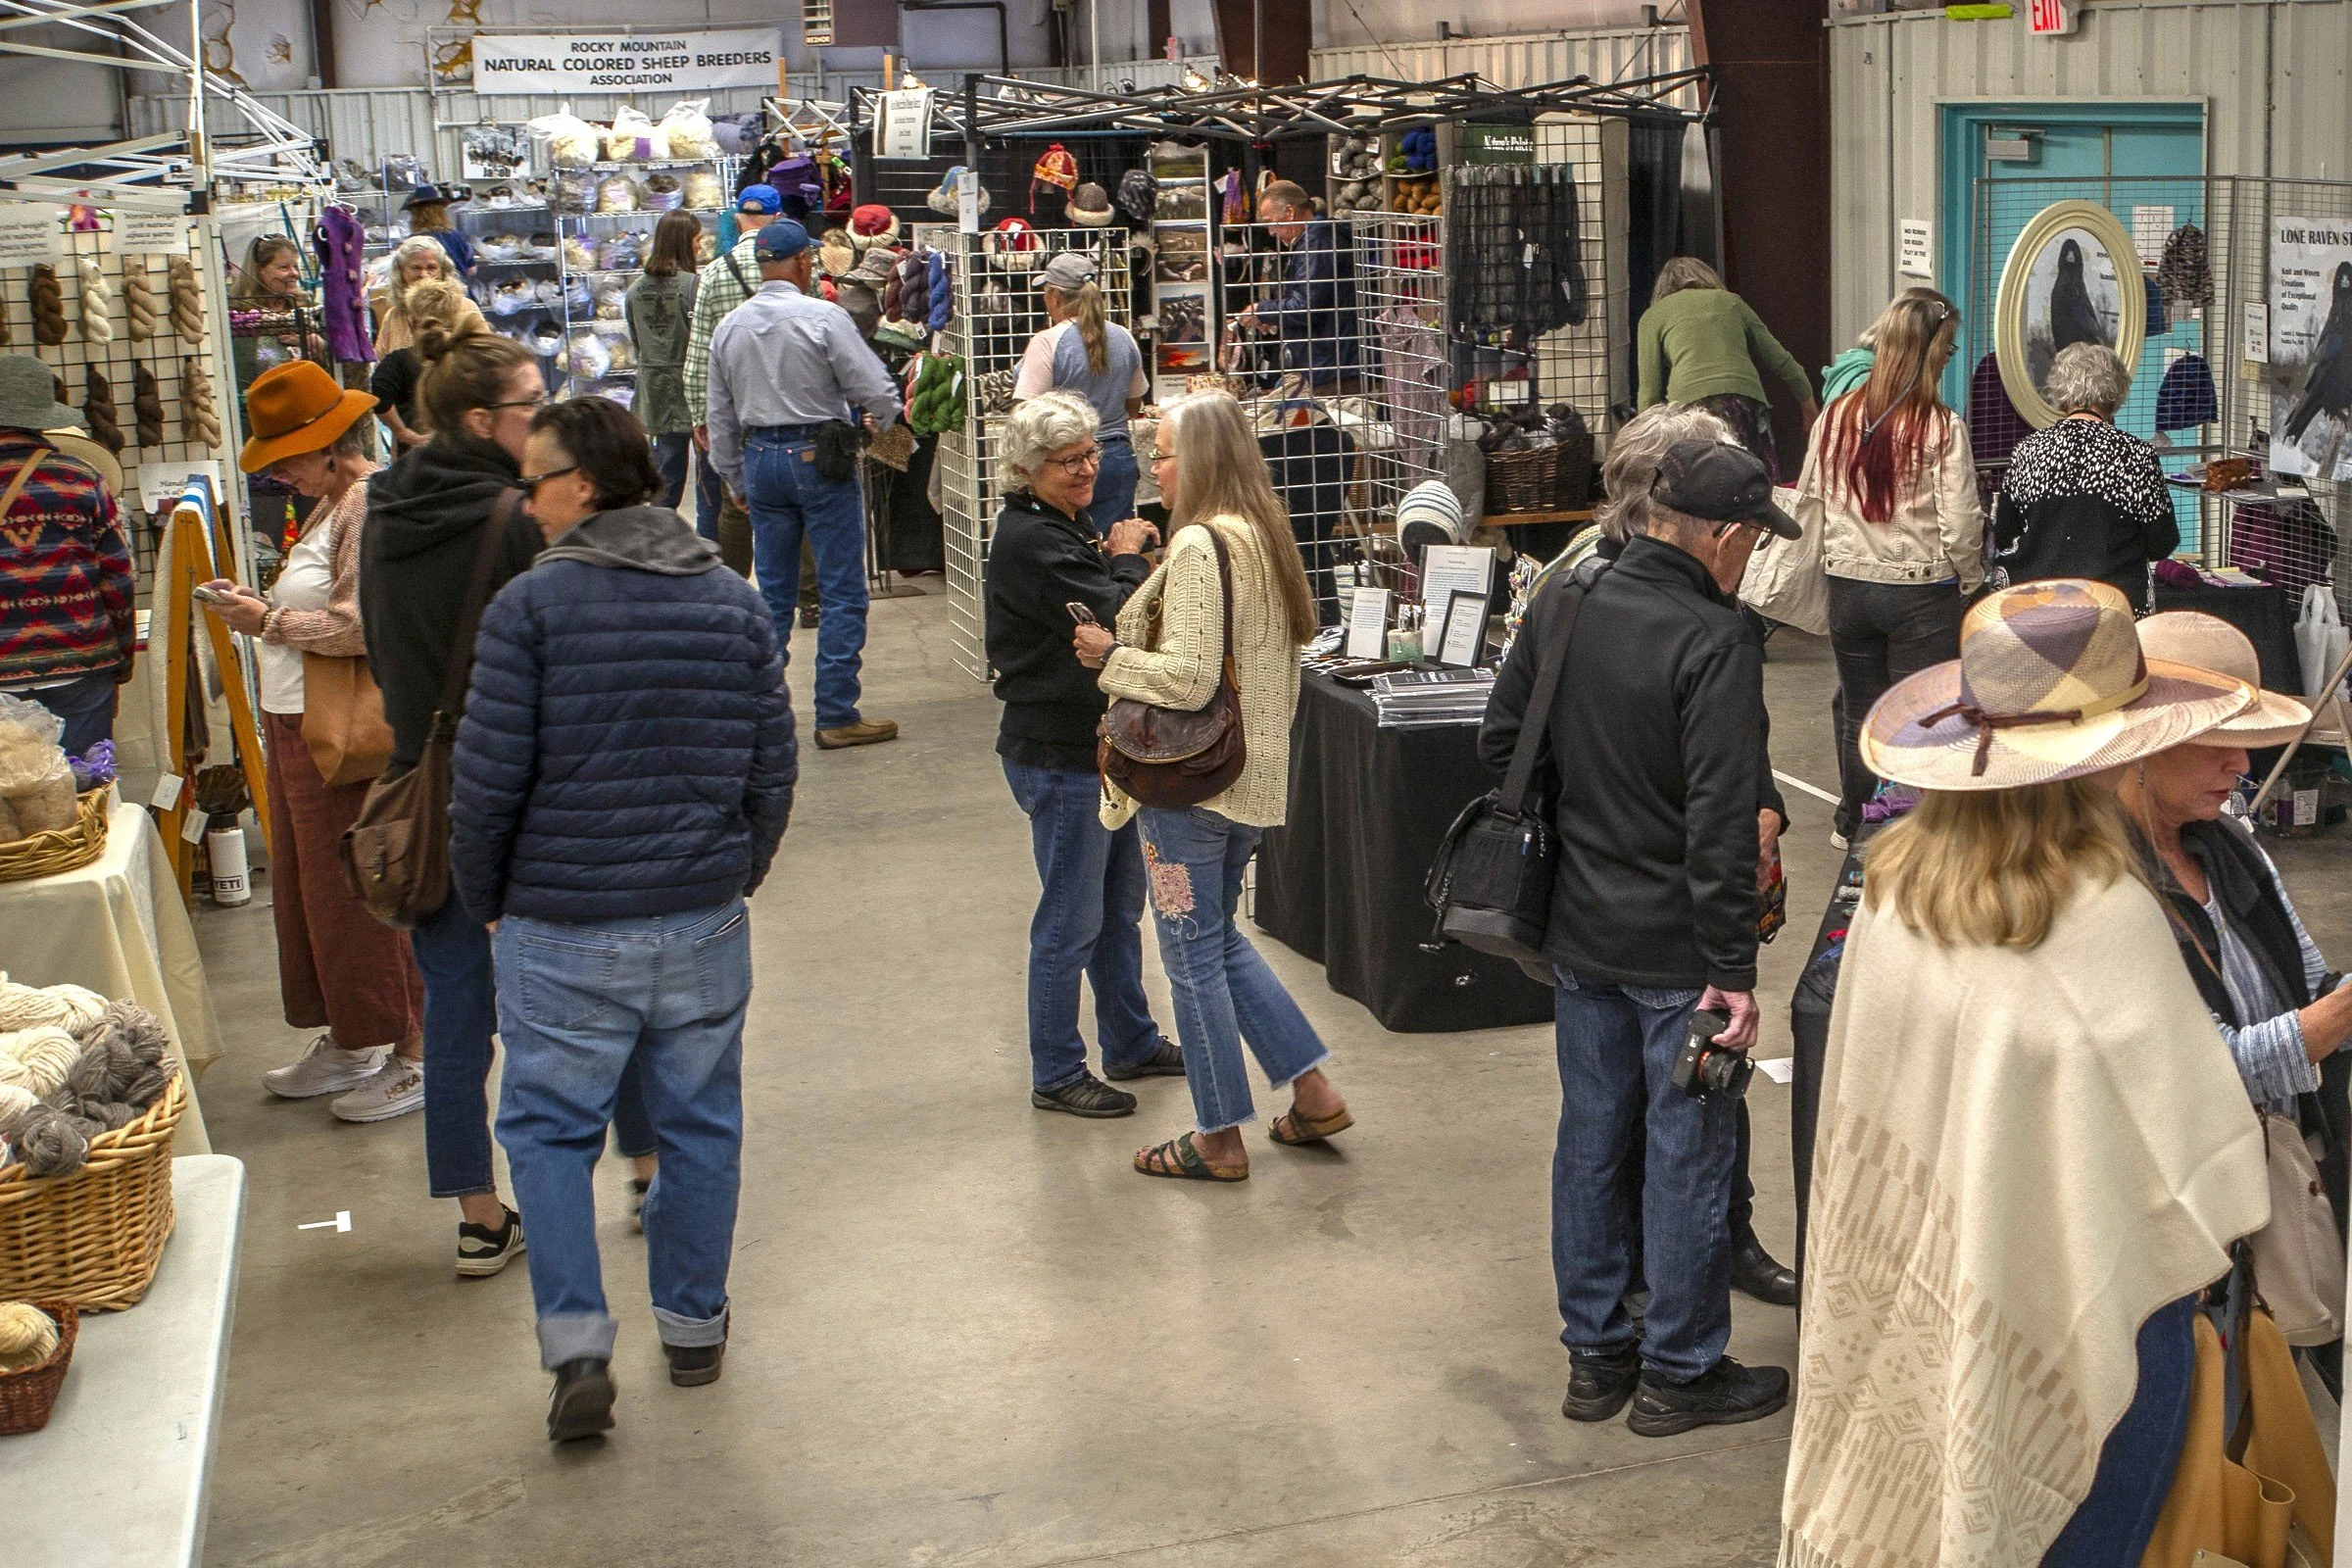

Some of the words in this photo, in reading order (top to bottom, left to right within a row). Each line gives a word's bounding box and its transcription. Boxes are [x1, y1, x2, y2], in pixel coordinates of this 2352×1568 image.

[571, 42, 613, 53] ROCKY
[619, 40, 686, 52] MOUNTAIN
[484, 59, 556, 72] NATURAL
[564, 58, 635, 71] COLORED
[642, 56, 690, 70] SHEEP
[697, 52, 771, 68] BREEDERS
[590, 74, 672, 85] ASSOCIATION
[2281, 229, 2306, 244] LONE
[2309, 230, 2340, 245] RAVEN
[2287, 291, 2316, 300] Exceptional
[2281, 303, 2298, 312] Quality
